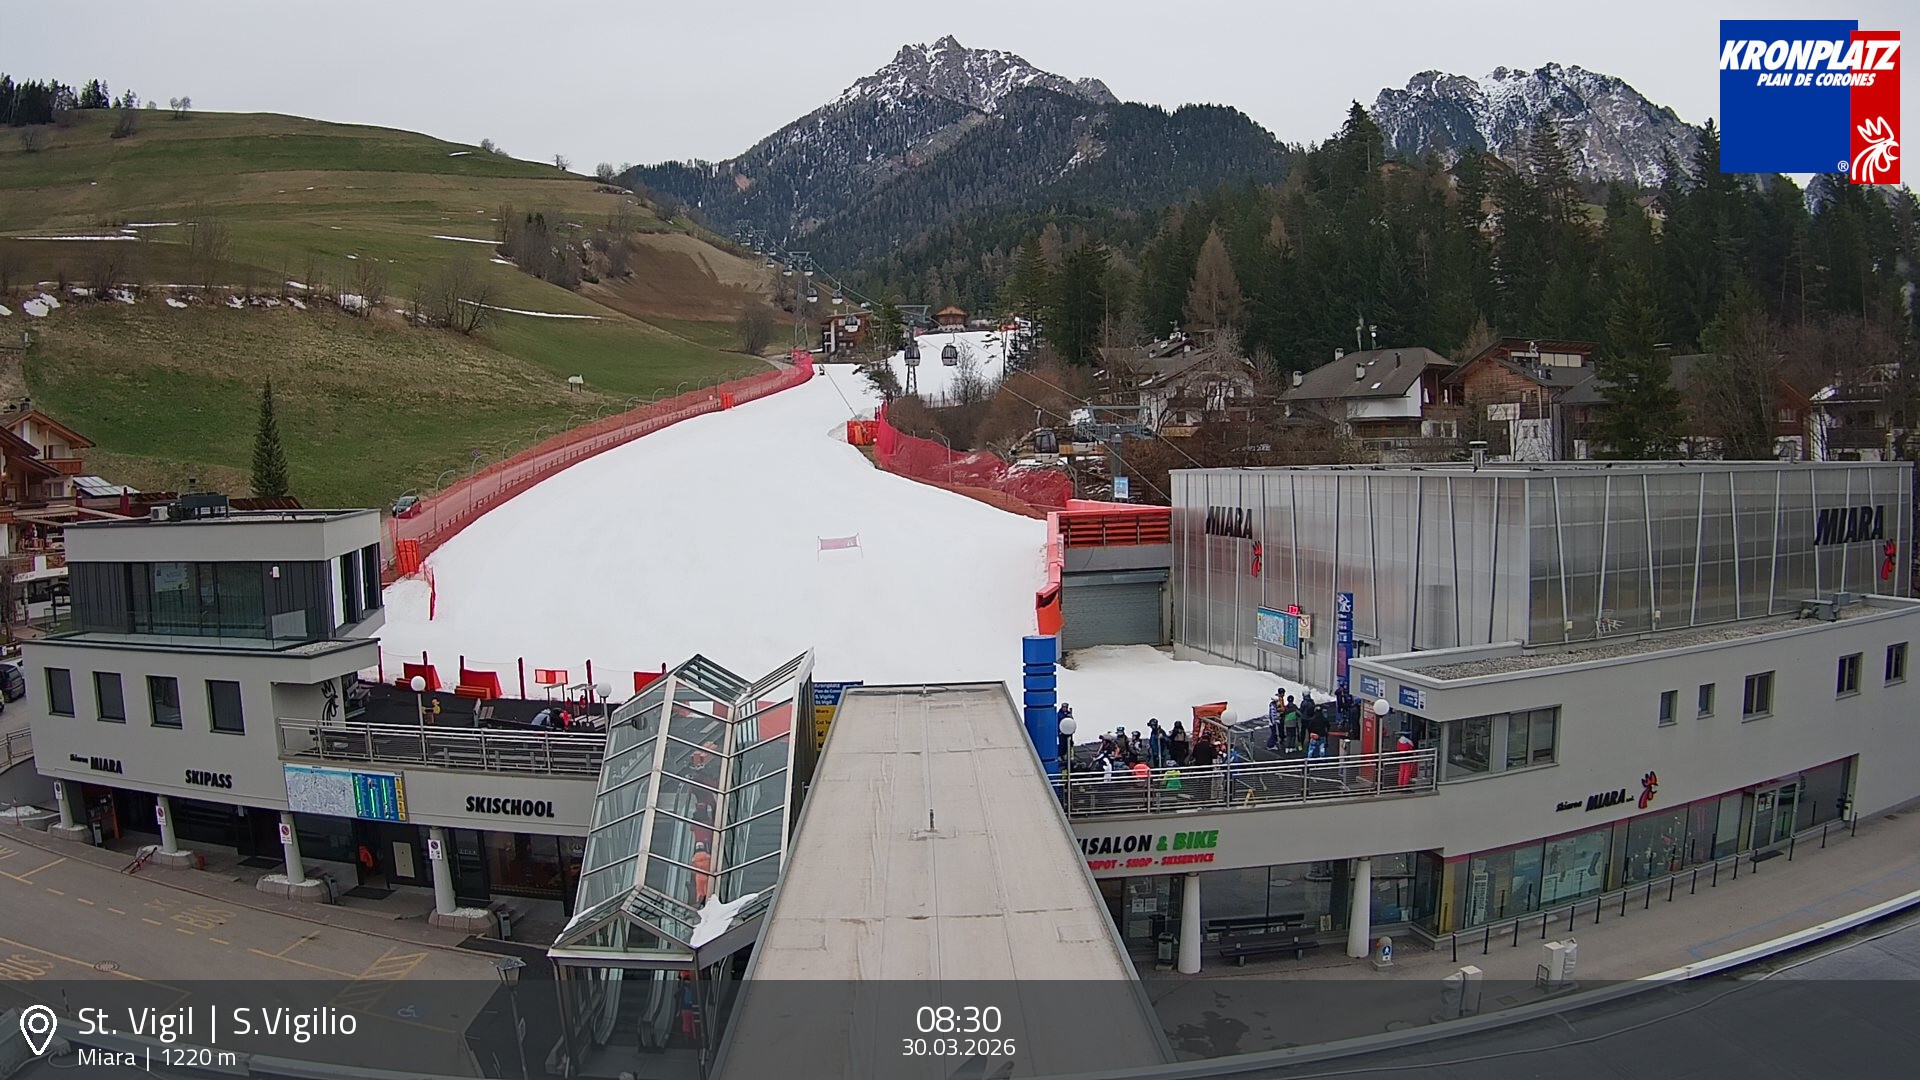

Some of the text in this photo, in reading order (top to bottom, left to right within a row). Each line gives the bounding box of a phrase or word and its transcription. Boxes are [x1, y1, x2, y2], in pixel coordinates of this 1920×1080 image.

[1205, 506, 1253, 539] MIARA
[1813, 505, 1884, 546] MIARA
[90, 756, 123, 774] MIARA
[185, 769, 233, 789] SKIPASS
[466, 796, 555, 818] SKISCHOOL
[1585, 788, 1626, 812] MIARA
[1077, 830, 1219, 855] ISALON & BIKE
